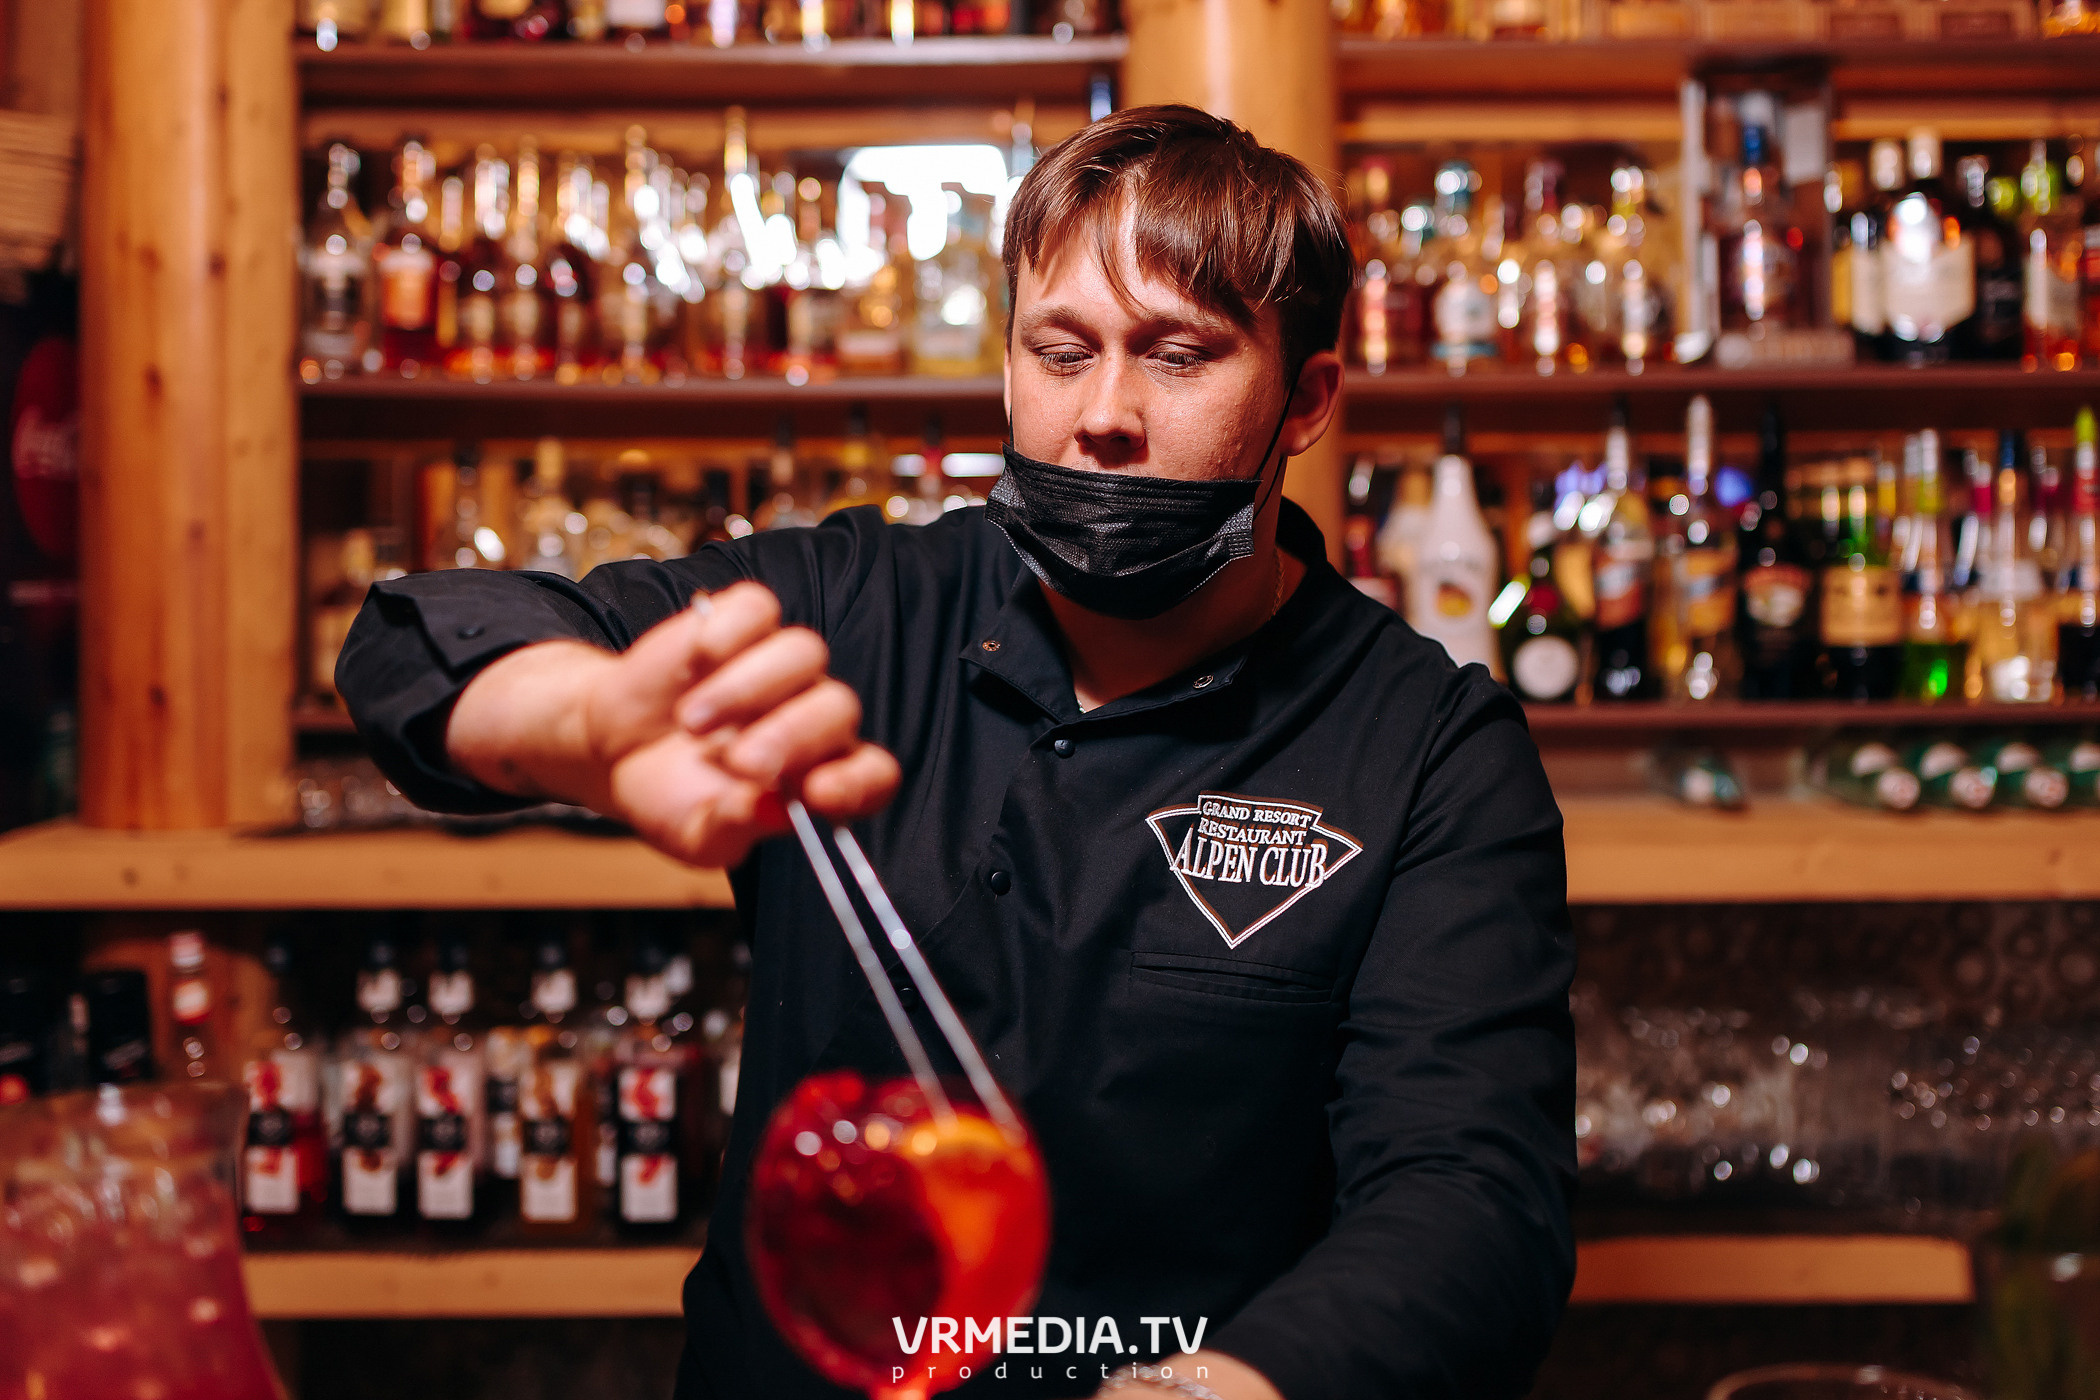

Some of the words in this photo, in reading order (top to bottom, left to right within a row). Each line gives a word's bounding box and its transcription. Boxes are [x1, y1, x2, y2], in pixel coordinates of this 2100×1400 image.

[1202, 801, 1250, 820] GRAND
[1253, 809, 1313, 829] RESORT
[1197, 817, 1307, 846] RESTAURANT
[1170, 826, 1258, 883] ALPEN
[1259, 843, 1328, 888] CLUB
